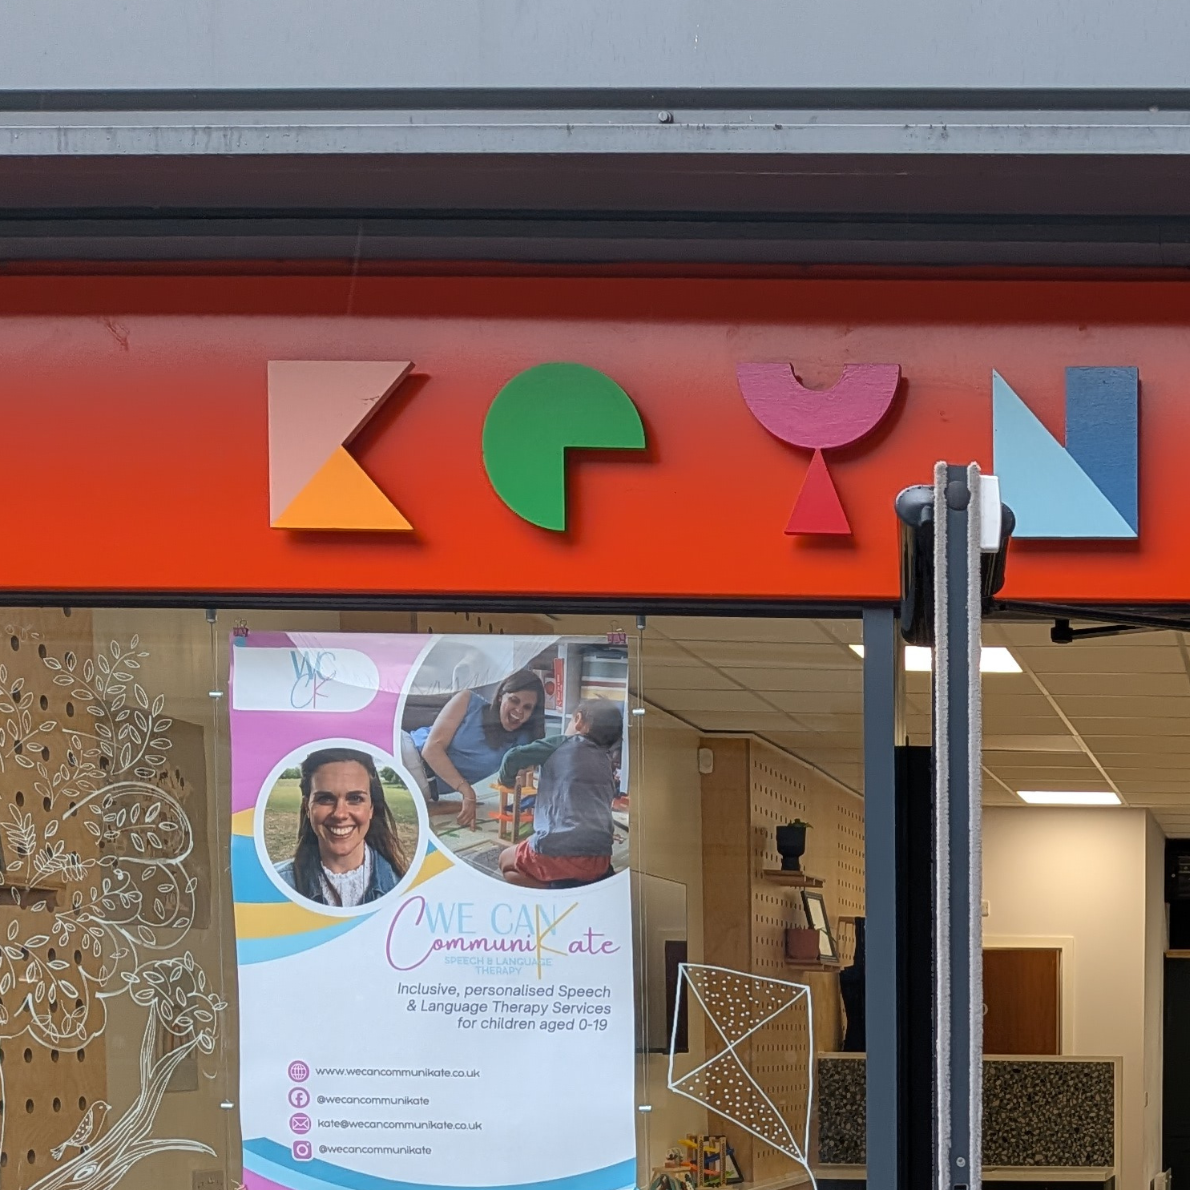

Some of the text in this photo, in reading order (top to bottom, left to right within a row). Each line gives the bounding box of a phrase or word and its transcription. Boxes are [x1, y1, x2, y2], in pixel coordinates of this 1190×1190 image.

[425, 902, 557, 936] WE CAN
[386, 895, 621, 979] CommuniKate
[445, 956, 485, 966] SPEECH
[496, 957, 552, 967] LANGUAGE
[475, 966, 522, 975] THERAPY
[397, 982, 612, 999] Inclusive, personalised Speech
[406, 1000, 612, 1016] & Language Therapy Services
[457, 1016, 608, 1033] for children aged 0-19
[315, 1067, 480, 1078] www.wecancommunikate.co.uk
[316, 1095, 430, 1106] @wecancommunikate
[317, 1119, 482, 1131] kate@wecancommunikate.co.uk
[318, 1144, 432, 1155] @wecancommunikate
